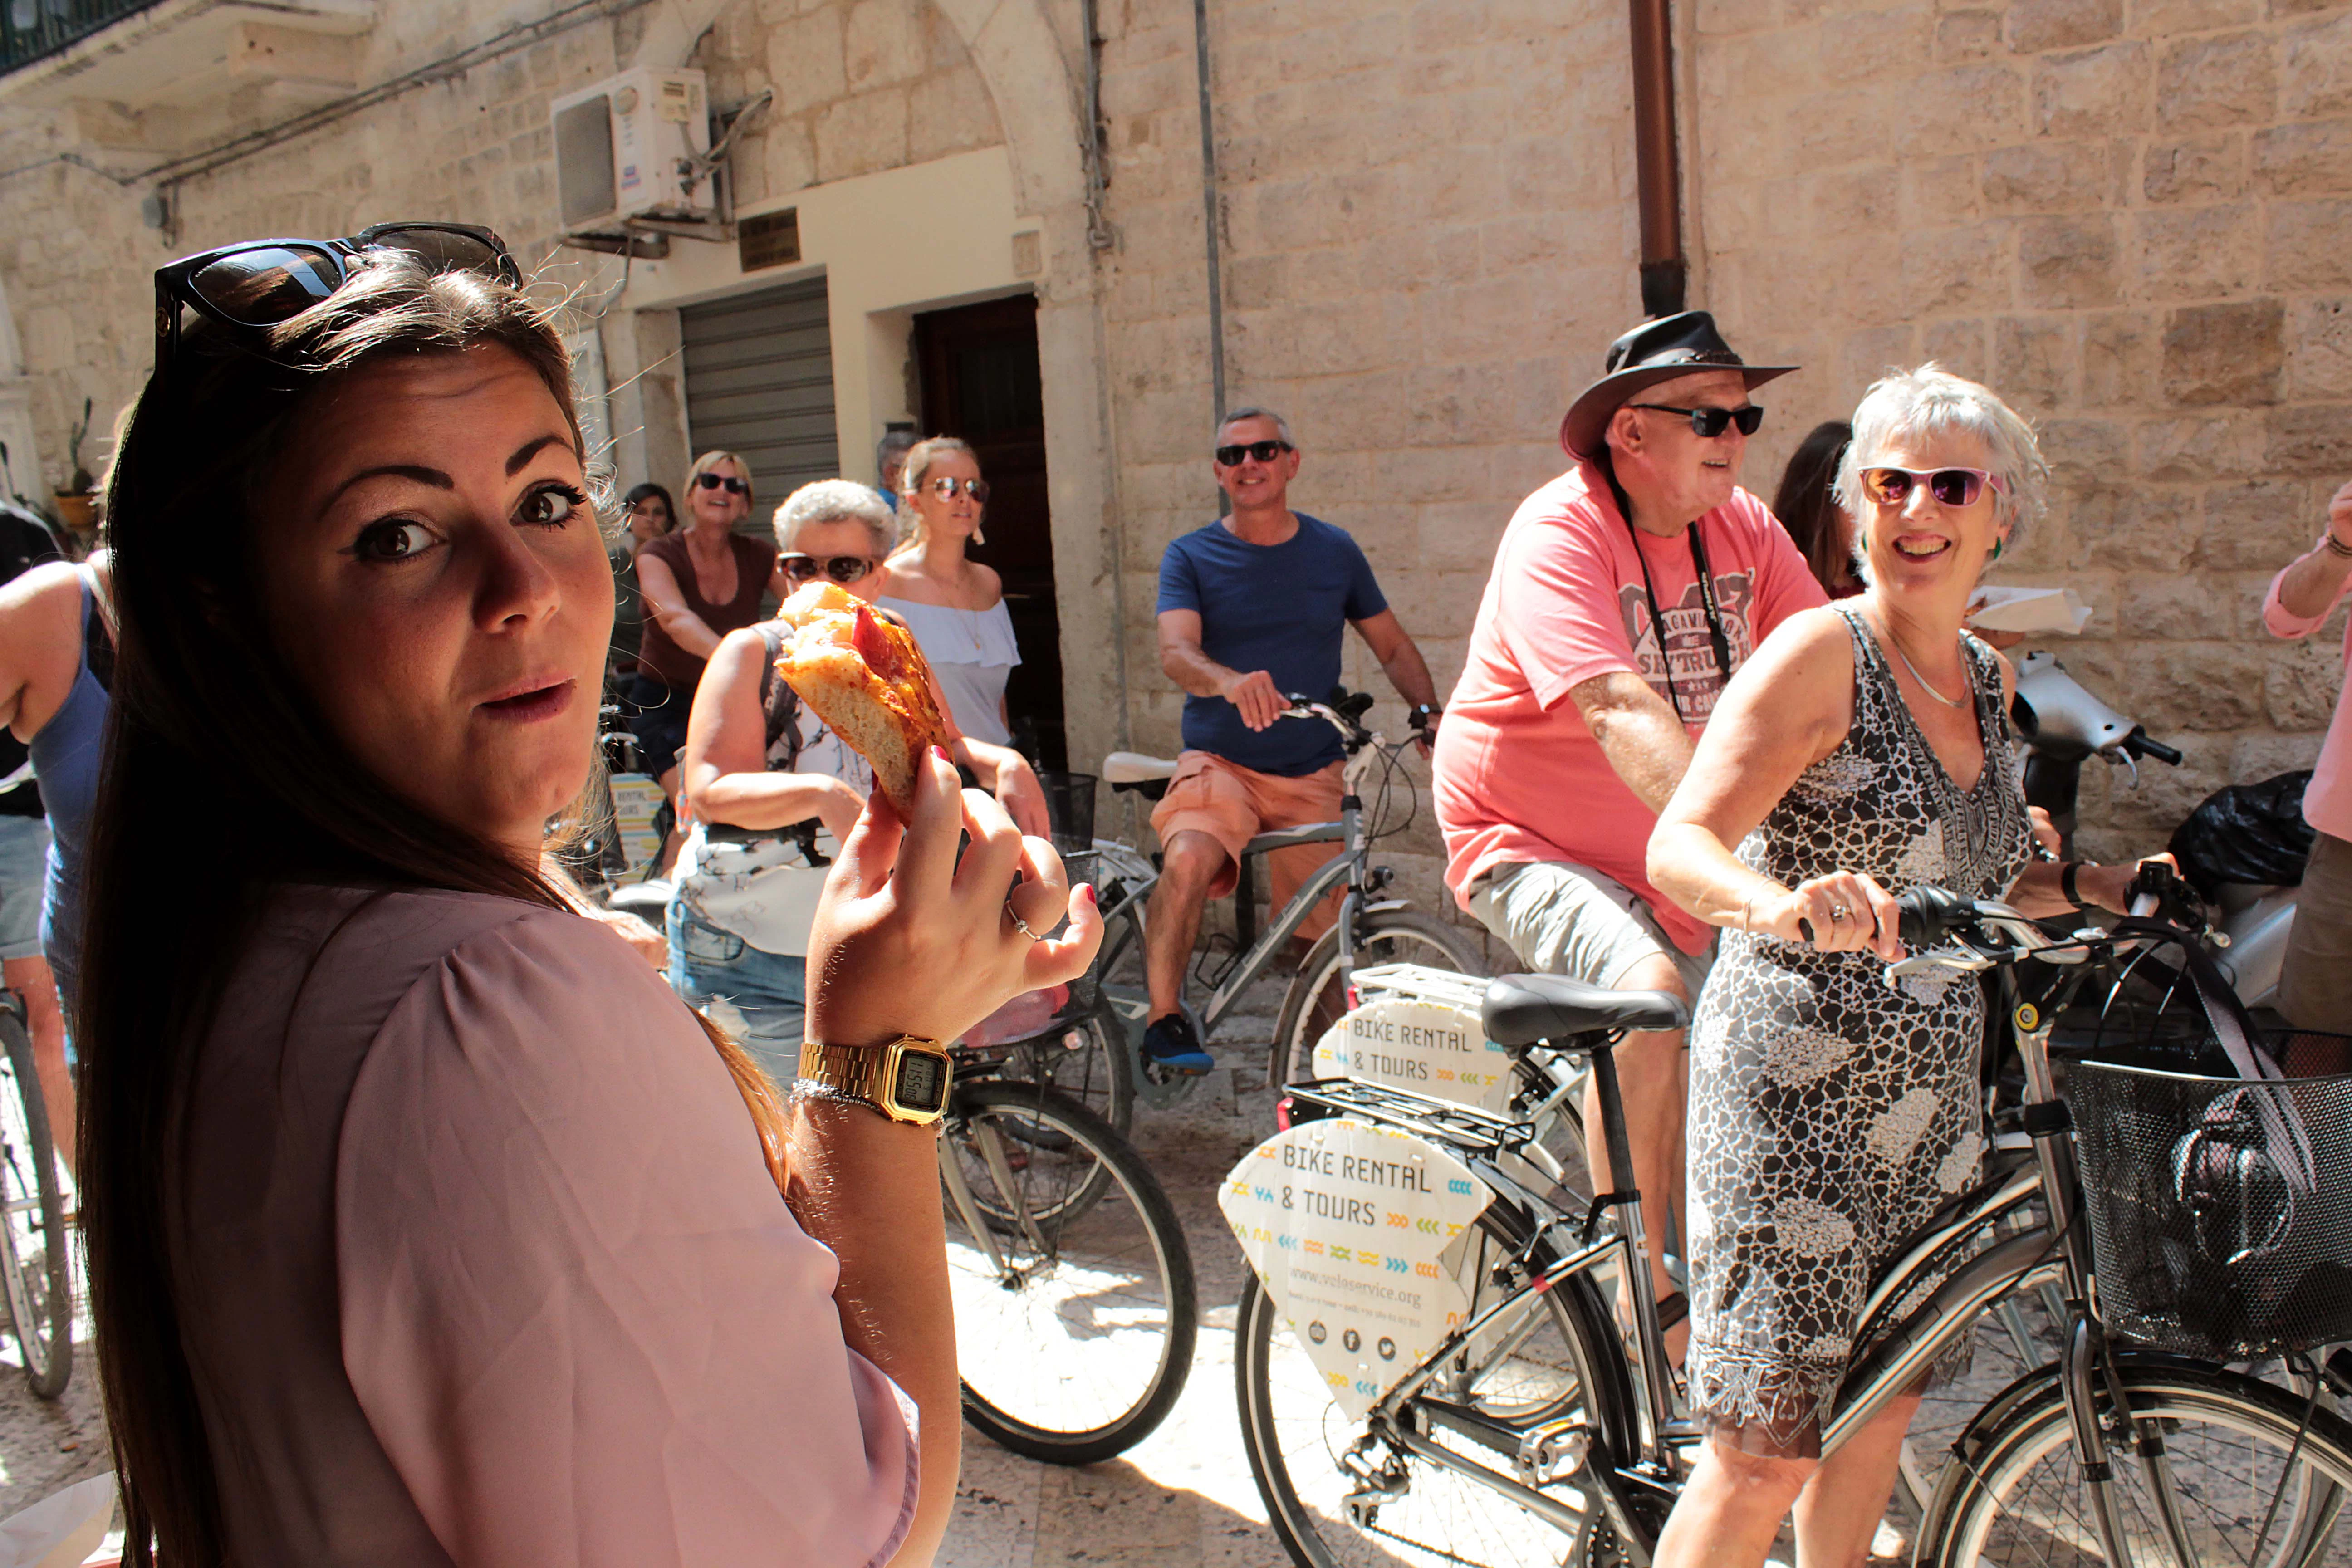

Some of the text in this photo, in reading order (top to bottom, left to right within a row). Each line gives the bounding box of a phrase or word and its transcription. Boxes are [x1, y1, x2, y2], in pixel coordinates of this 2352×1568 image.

[1354, 1018, 1472, 1052] BIKE RENTAL
[1354, 1051, 1429, 1080] & TOURS
[1284, 1144, 1431, 1193] BIKE RENTAL
[1282, 1186, 1375, 1226] & TOURS
[1290, 1269, 1422, 1310] www.veloservice.org
